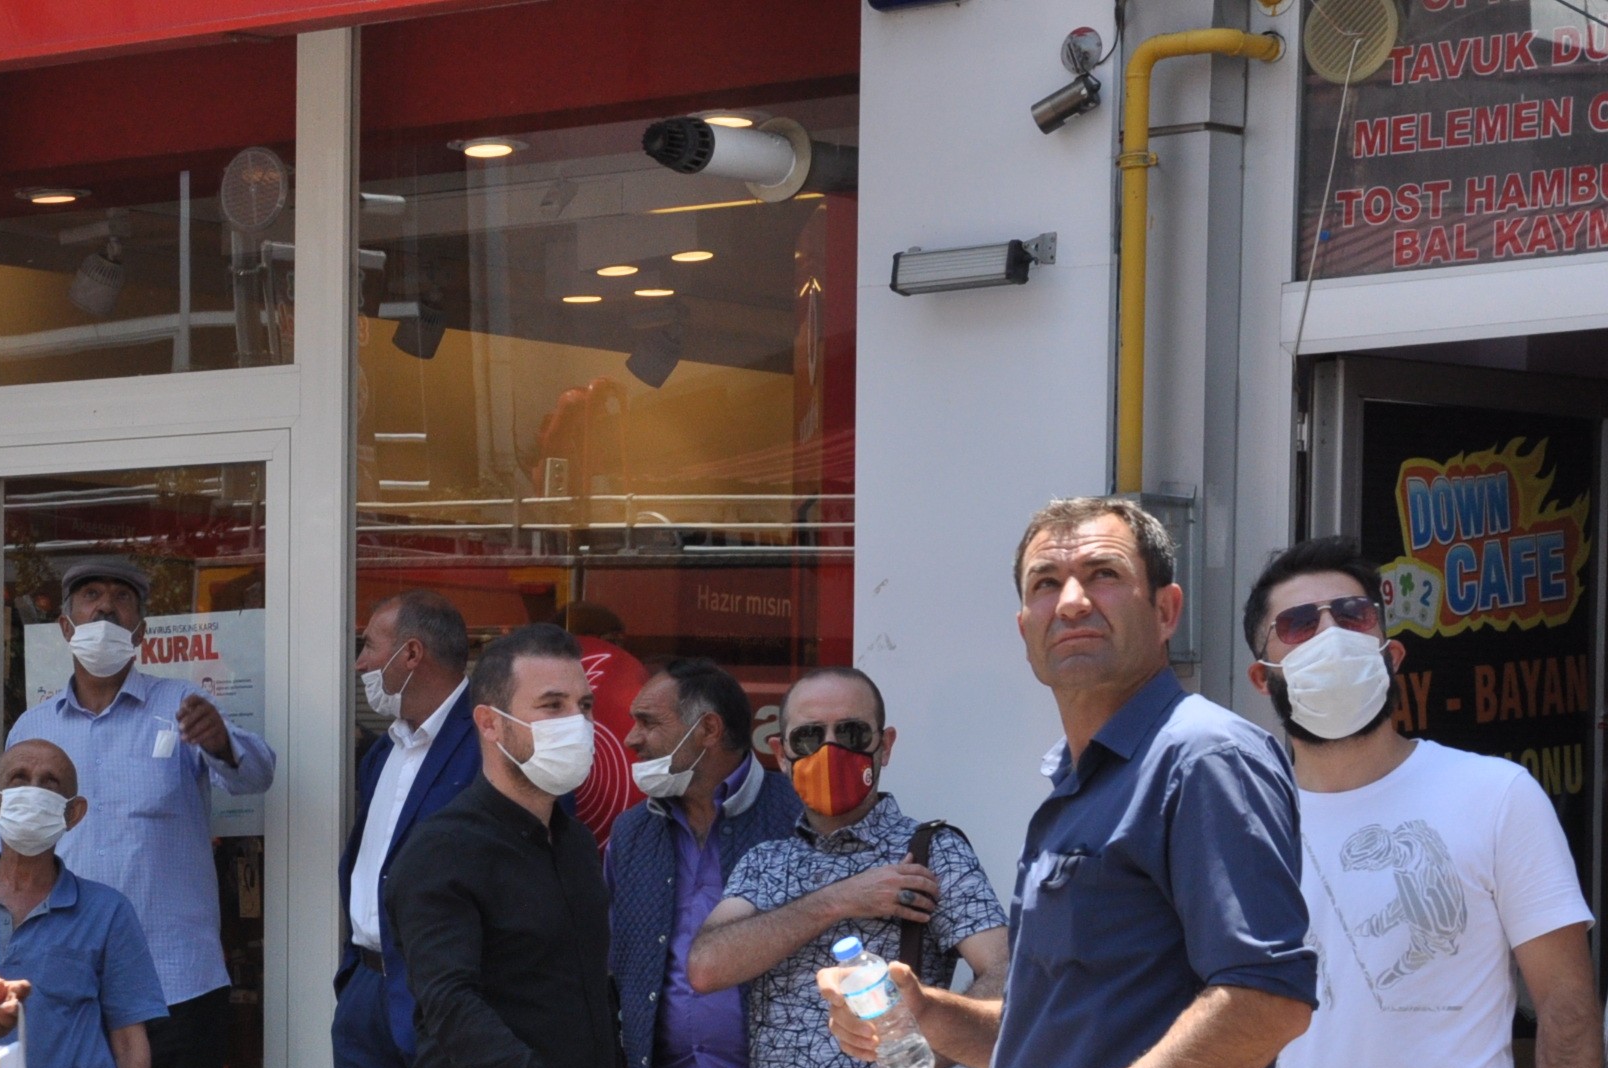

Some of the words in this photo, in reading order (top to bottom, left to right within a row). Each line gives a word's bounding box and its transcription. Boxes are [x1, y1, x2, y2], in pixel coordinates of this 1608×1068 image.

[1388, 29, 1539, 86] TAVUK
[1353, 95, 1574, 159] MELEMEN
[1334, 179, 1452, 228] TOST
[1393, 222, 1479, 269] BAL
[1406, 470, 1511, 550] DOWN
[697, 584, 742, 613] Hazır
[746, 594, 792, 617] mısın
[1445, 530, 1567, 616] CAFE
[141, 633, 219, 665] KURAL
[1475, 654, 1590, 724] BAYAN
